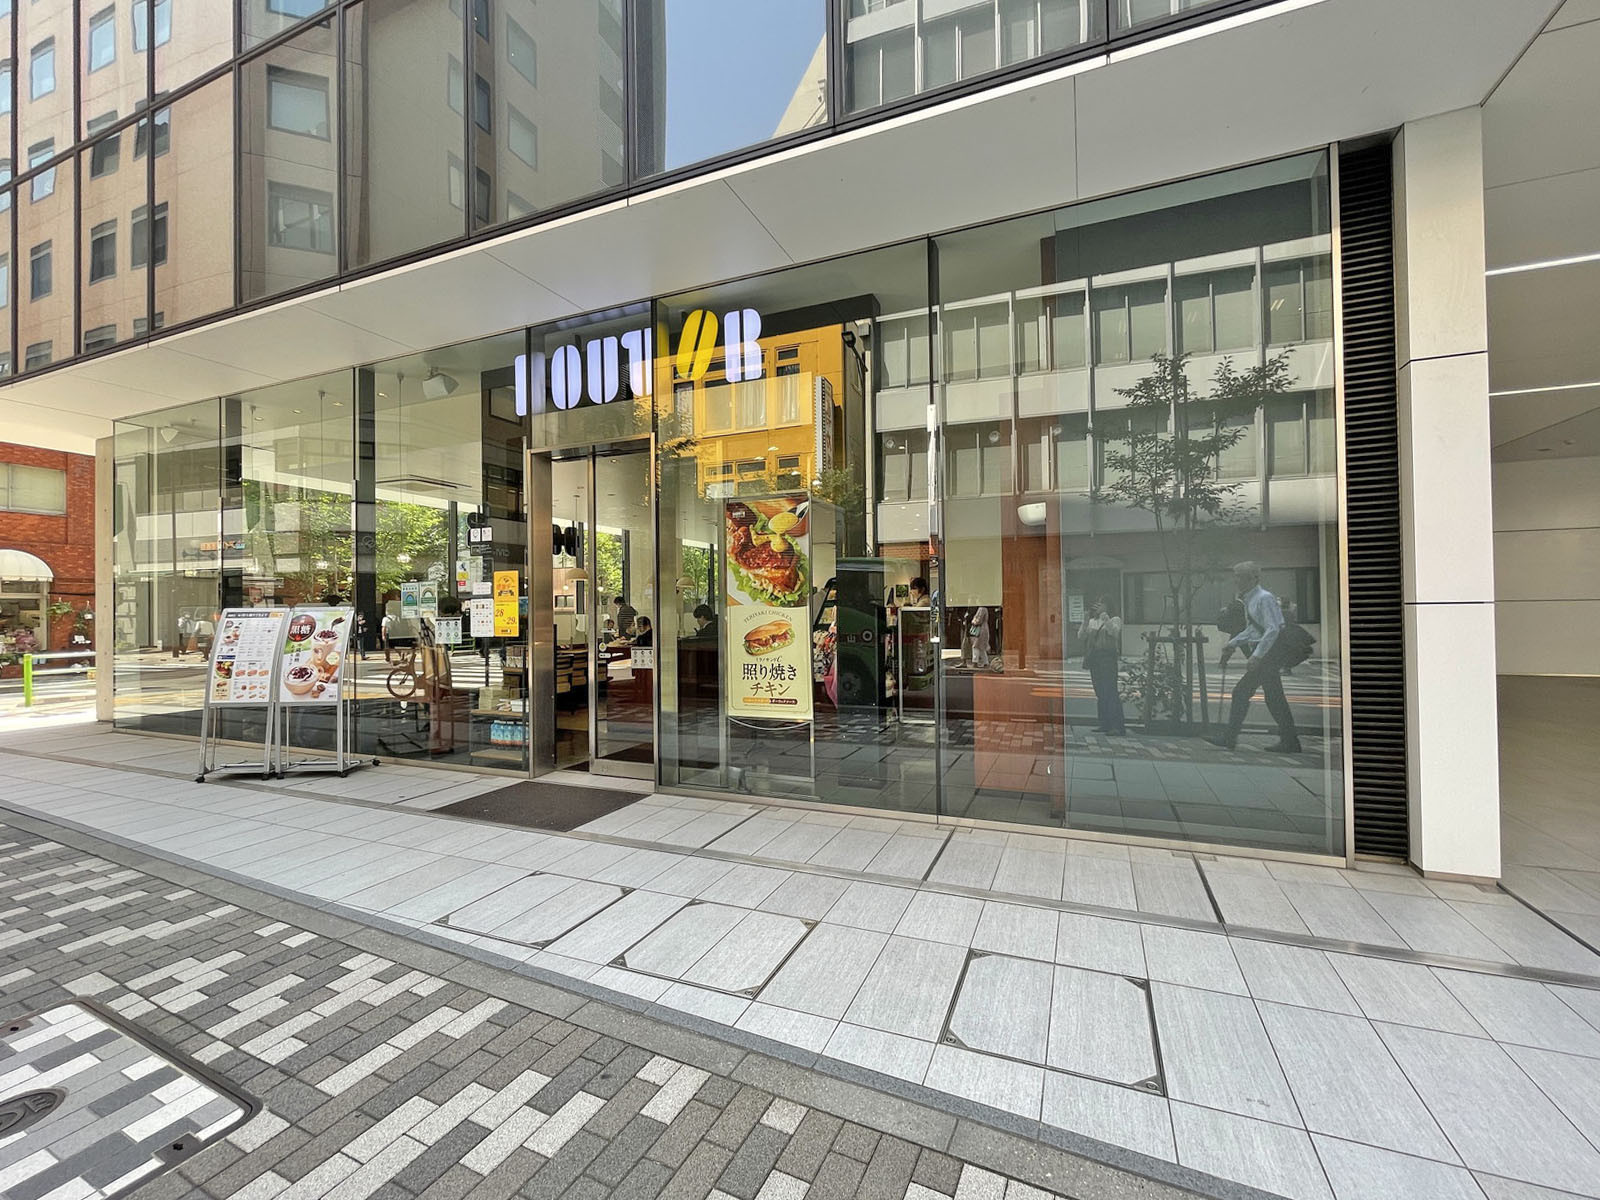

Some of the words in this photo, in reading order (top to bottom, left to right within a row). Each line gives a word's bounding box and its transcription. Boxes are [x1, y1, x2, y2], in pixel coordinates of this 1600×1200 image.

[768, 610, 792, 622] CHICKEN
[742, 663, 797, 681] 照り焼き
[750, 682, 790, 697] チキン
